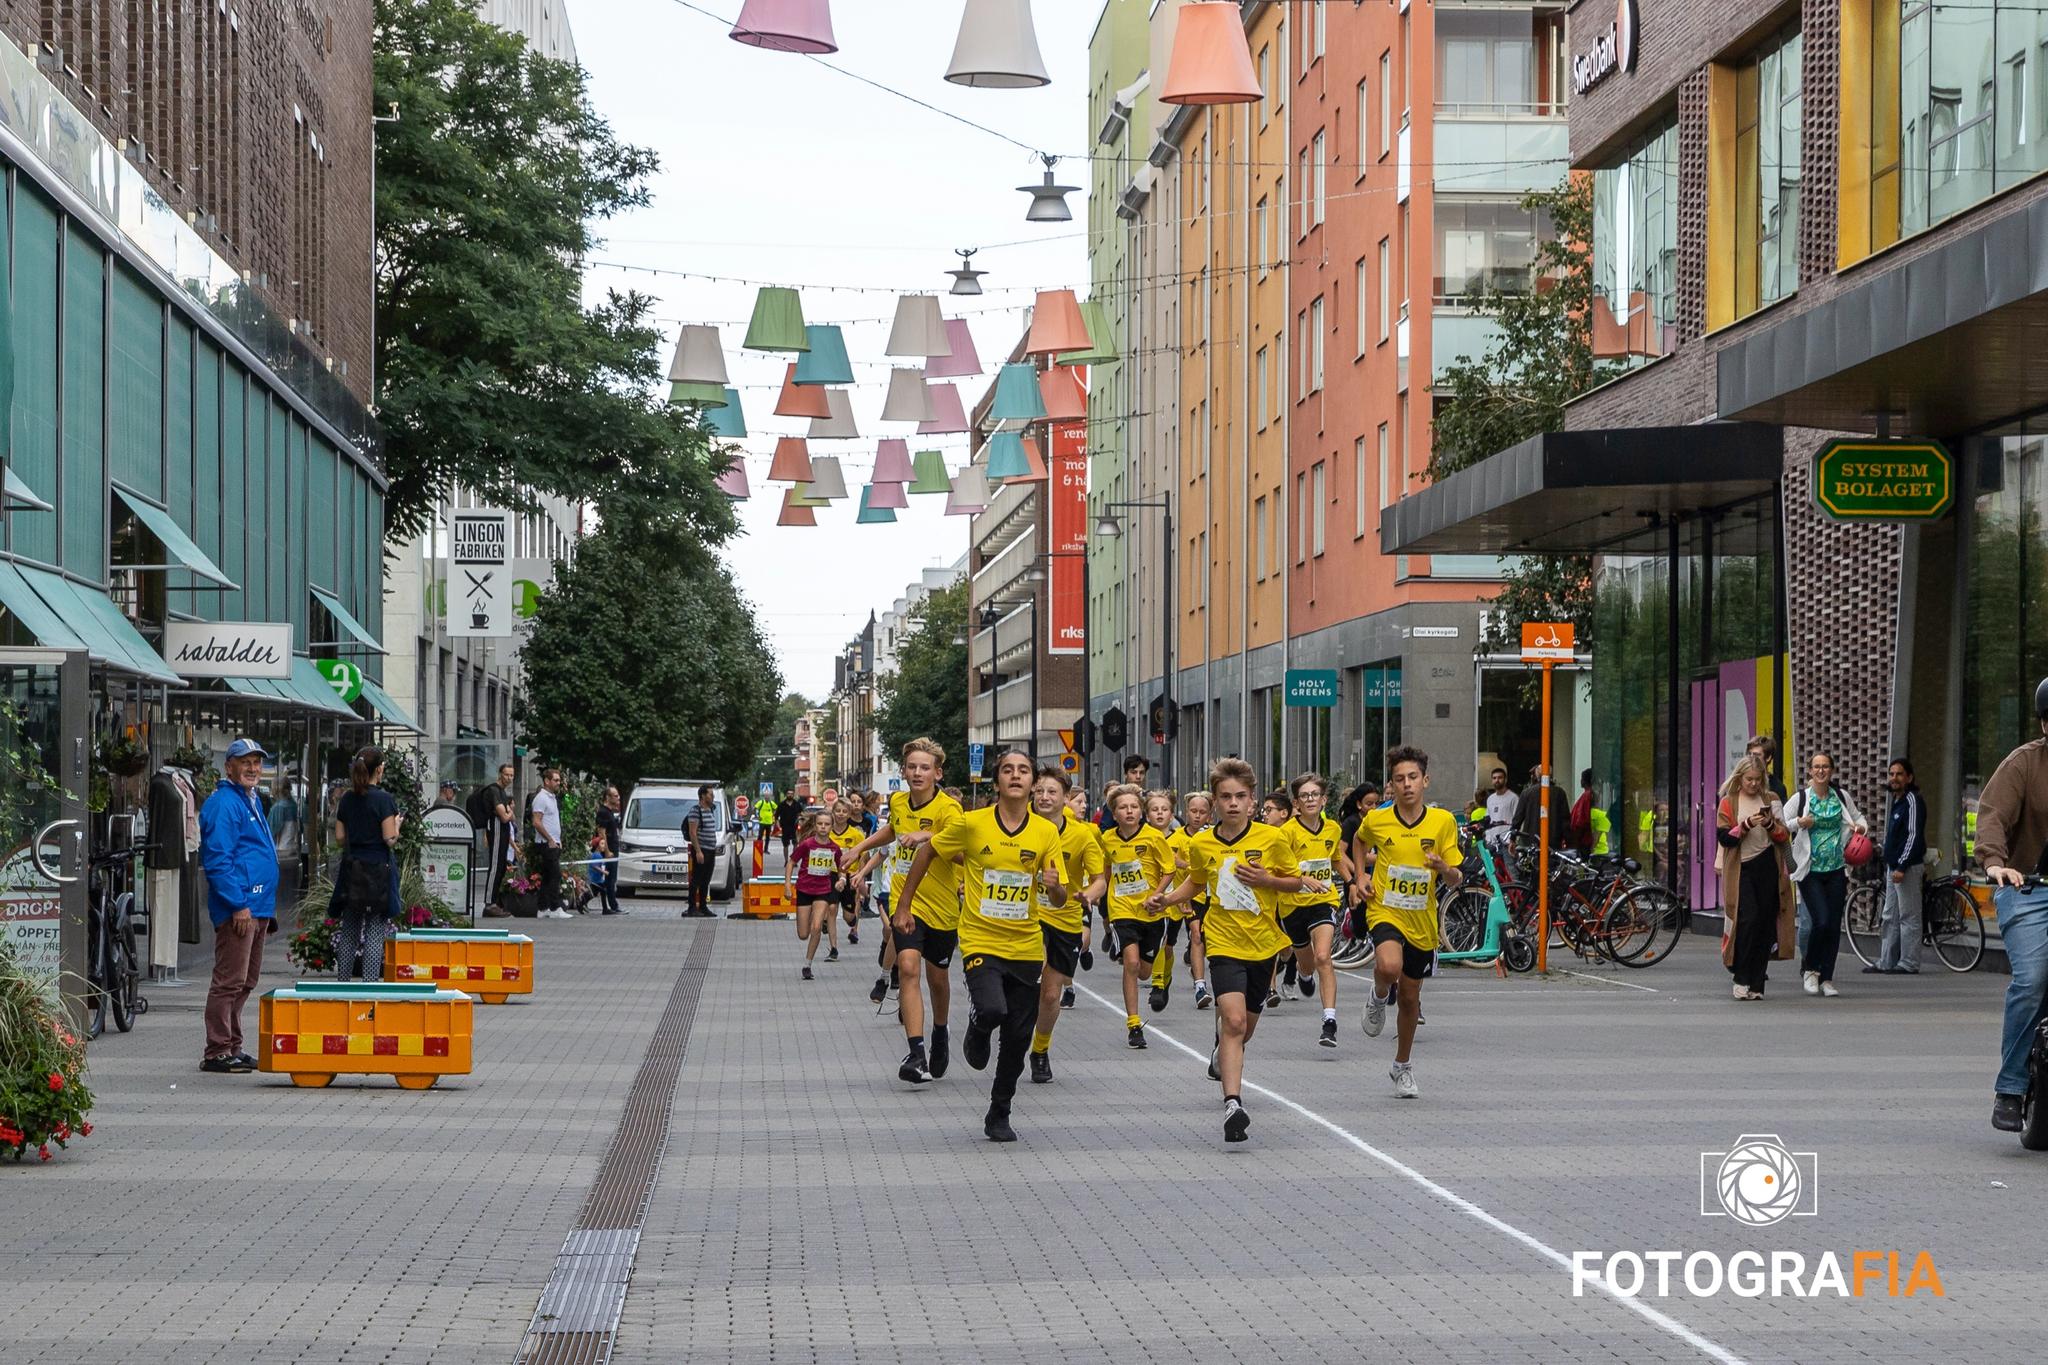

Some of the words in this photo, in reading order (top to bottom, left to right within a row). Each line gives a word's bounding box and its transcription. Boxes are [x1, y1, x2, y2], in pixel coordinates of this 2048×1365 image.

[1574, 22, 1617, 95] Swedbank
[1841, 463, 1928, 477] SYSTEM
[1835, 482, 1936, 496] BOLAGET
[455, 523, 504, 542] LINGON
[455, 543, 504, 558] FABRIKEN
[175, 636, 280, 664] rabalder
[811, 858, 832, 867] 1511
[1114, 869, 1143, 884] 1551
[986, 883, 1029, 902] 1575
[1389, 878, 1428, 896] 1613
[17, 926, 60, 939] ÖPPET
